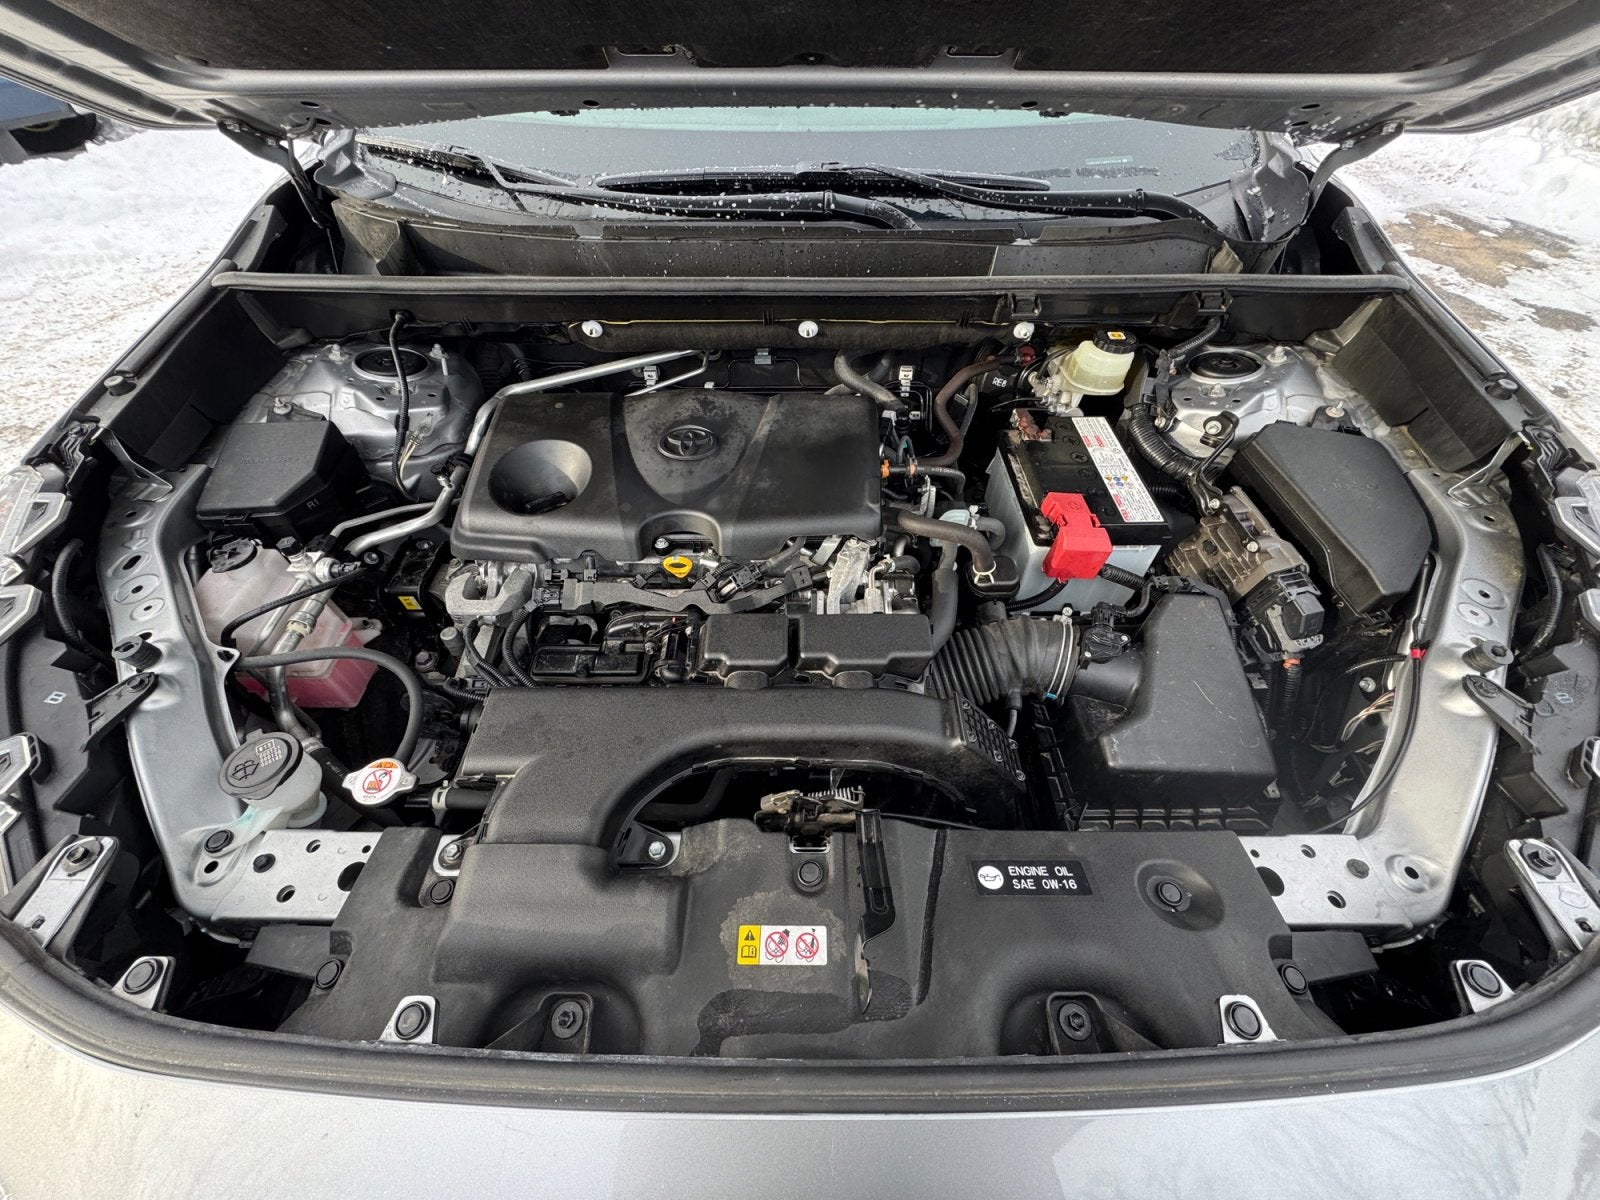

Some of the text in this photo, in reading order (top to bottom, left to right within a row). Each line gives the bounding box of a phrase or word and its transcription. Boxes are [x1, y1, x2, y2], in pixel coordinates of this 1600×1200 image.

[1007, 865, 1074, 877] ENGINE OIL
[1012, 879, 1078, 890] SAE 0W-16
